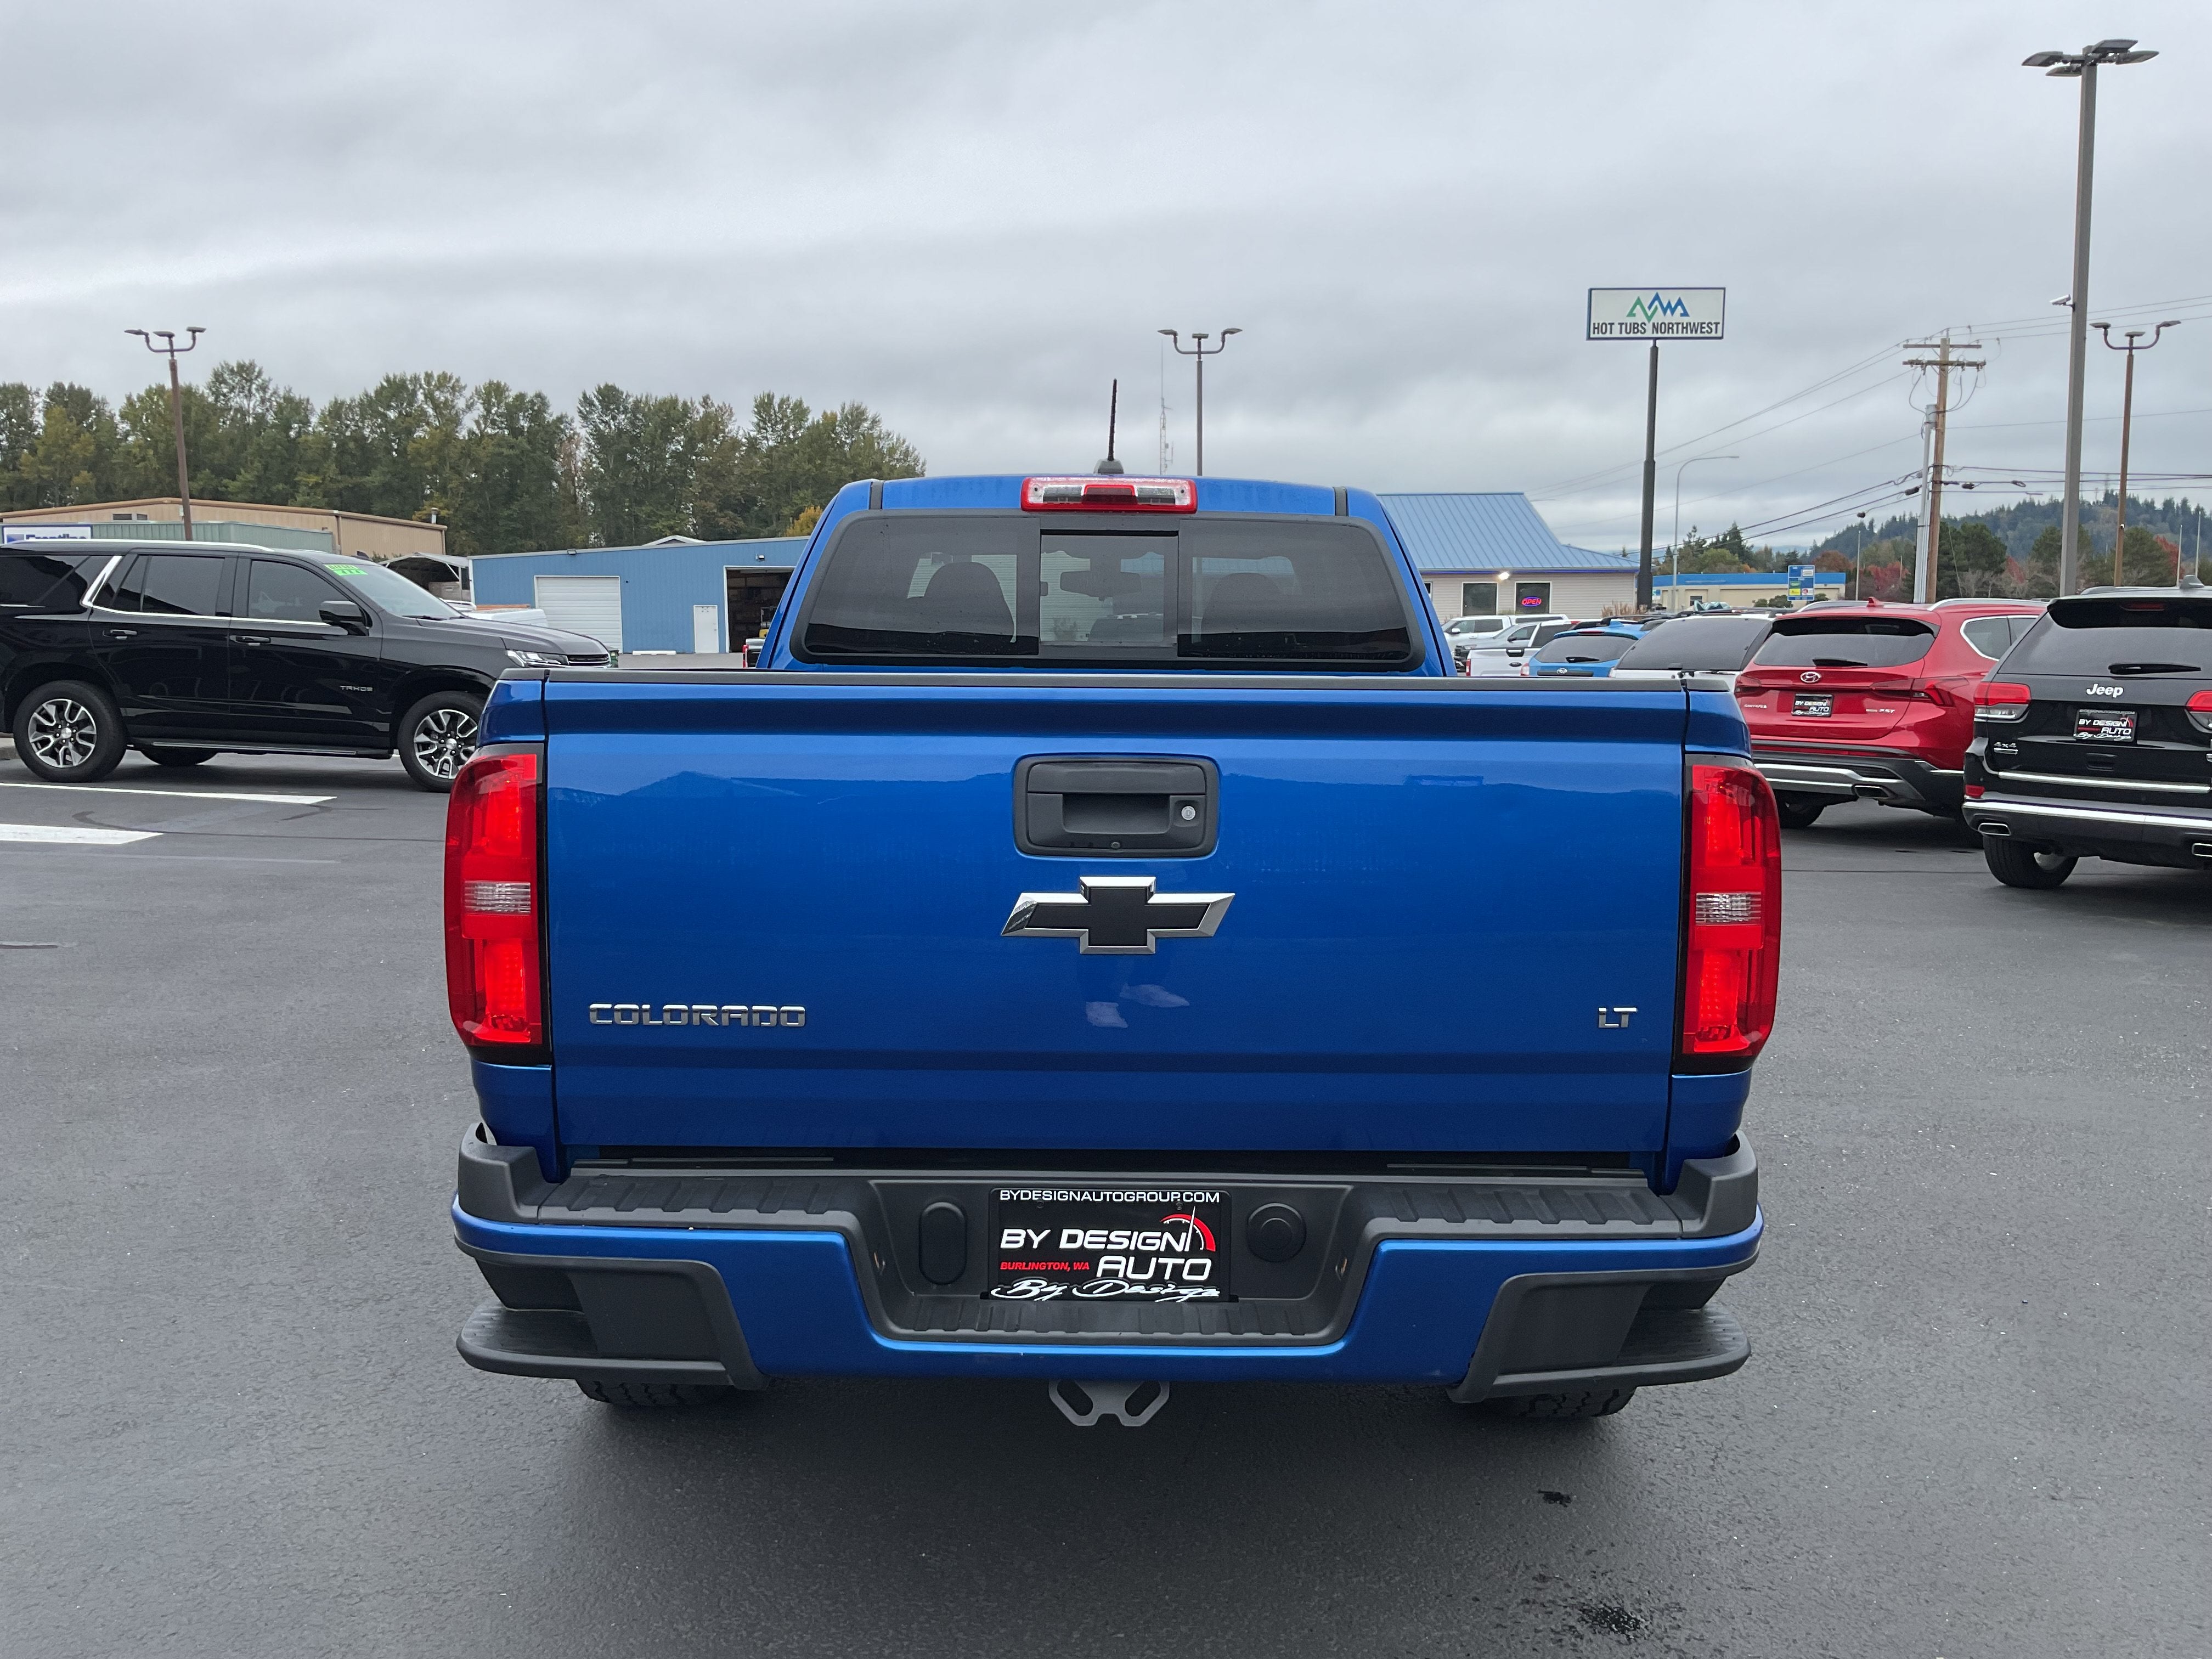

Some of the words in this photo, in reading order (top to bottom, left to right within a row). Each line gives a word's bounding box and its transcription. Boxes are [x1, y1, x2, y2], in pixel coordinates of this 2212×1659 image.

[1593, 322, 1615, 335] HOT
[1618, 322, 1646, 335] TUBS
[1651, 321, 1720, 334] NORTHWEST
[2086, 683, 2124, 698] Jeep
[2101, 727, 2131, 735] AUTO
[589, 1003, 806, 1027] COLORADO
[1598, 1007, 1638, 1028] LT
[1000, 1190, 1220, 1203] BYDESIGNAUTOGROUP.COM
[1000, 1228, 1051, 1249] BY
[1059, 1228, 1187, 1252] DESIGN
[1000, 1262, 1070, 1272] BURLINGTON,
[1096, 1255, 1212, 1280] AUTO
[990, 1279, 1068, 1301] By
[1072, 1279, 1221, 1302] Design
